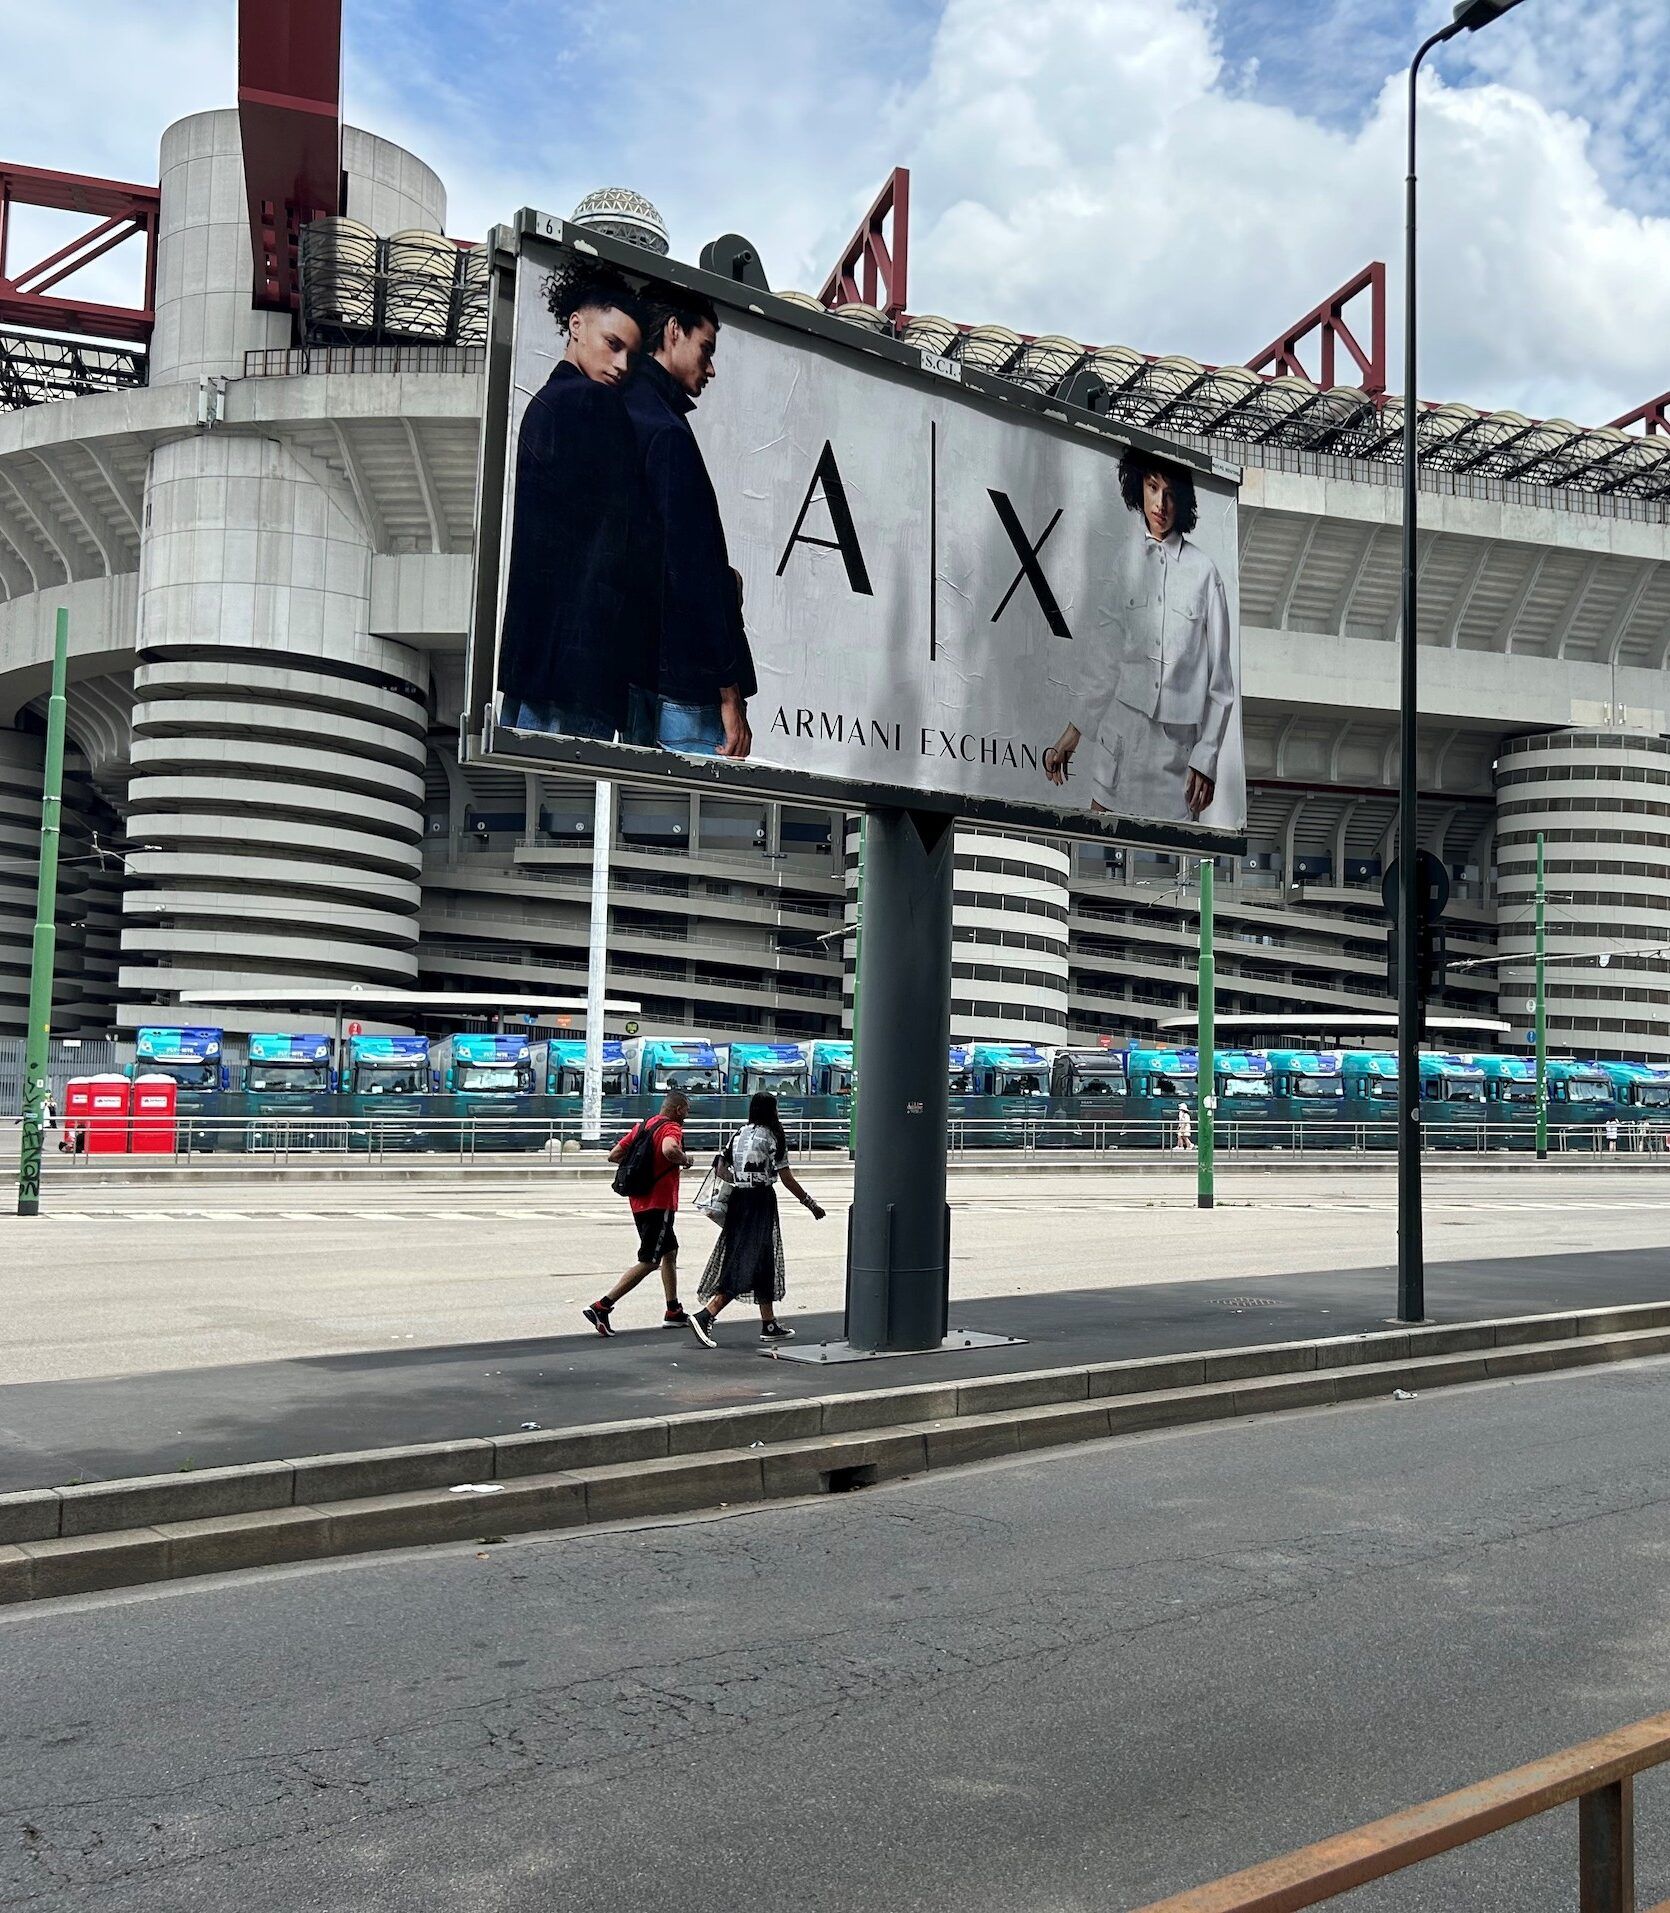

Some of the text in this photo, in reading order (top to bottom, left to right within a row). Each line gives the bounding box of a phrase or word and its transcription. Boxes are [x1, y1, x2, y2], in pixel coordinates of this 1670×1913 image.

[546, 219, 553, 234] 6
[925, 355, 957, 377] S.C.I.
[770, 705, 901, 751] ARMANI
